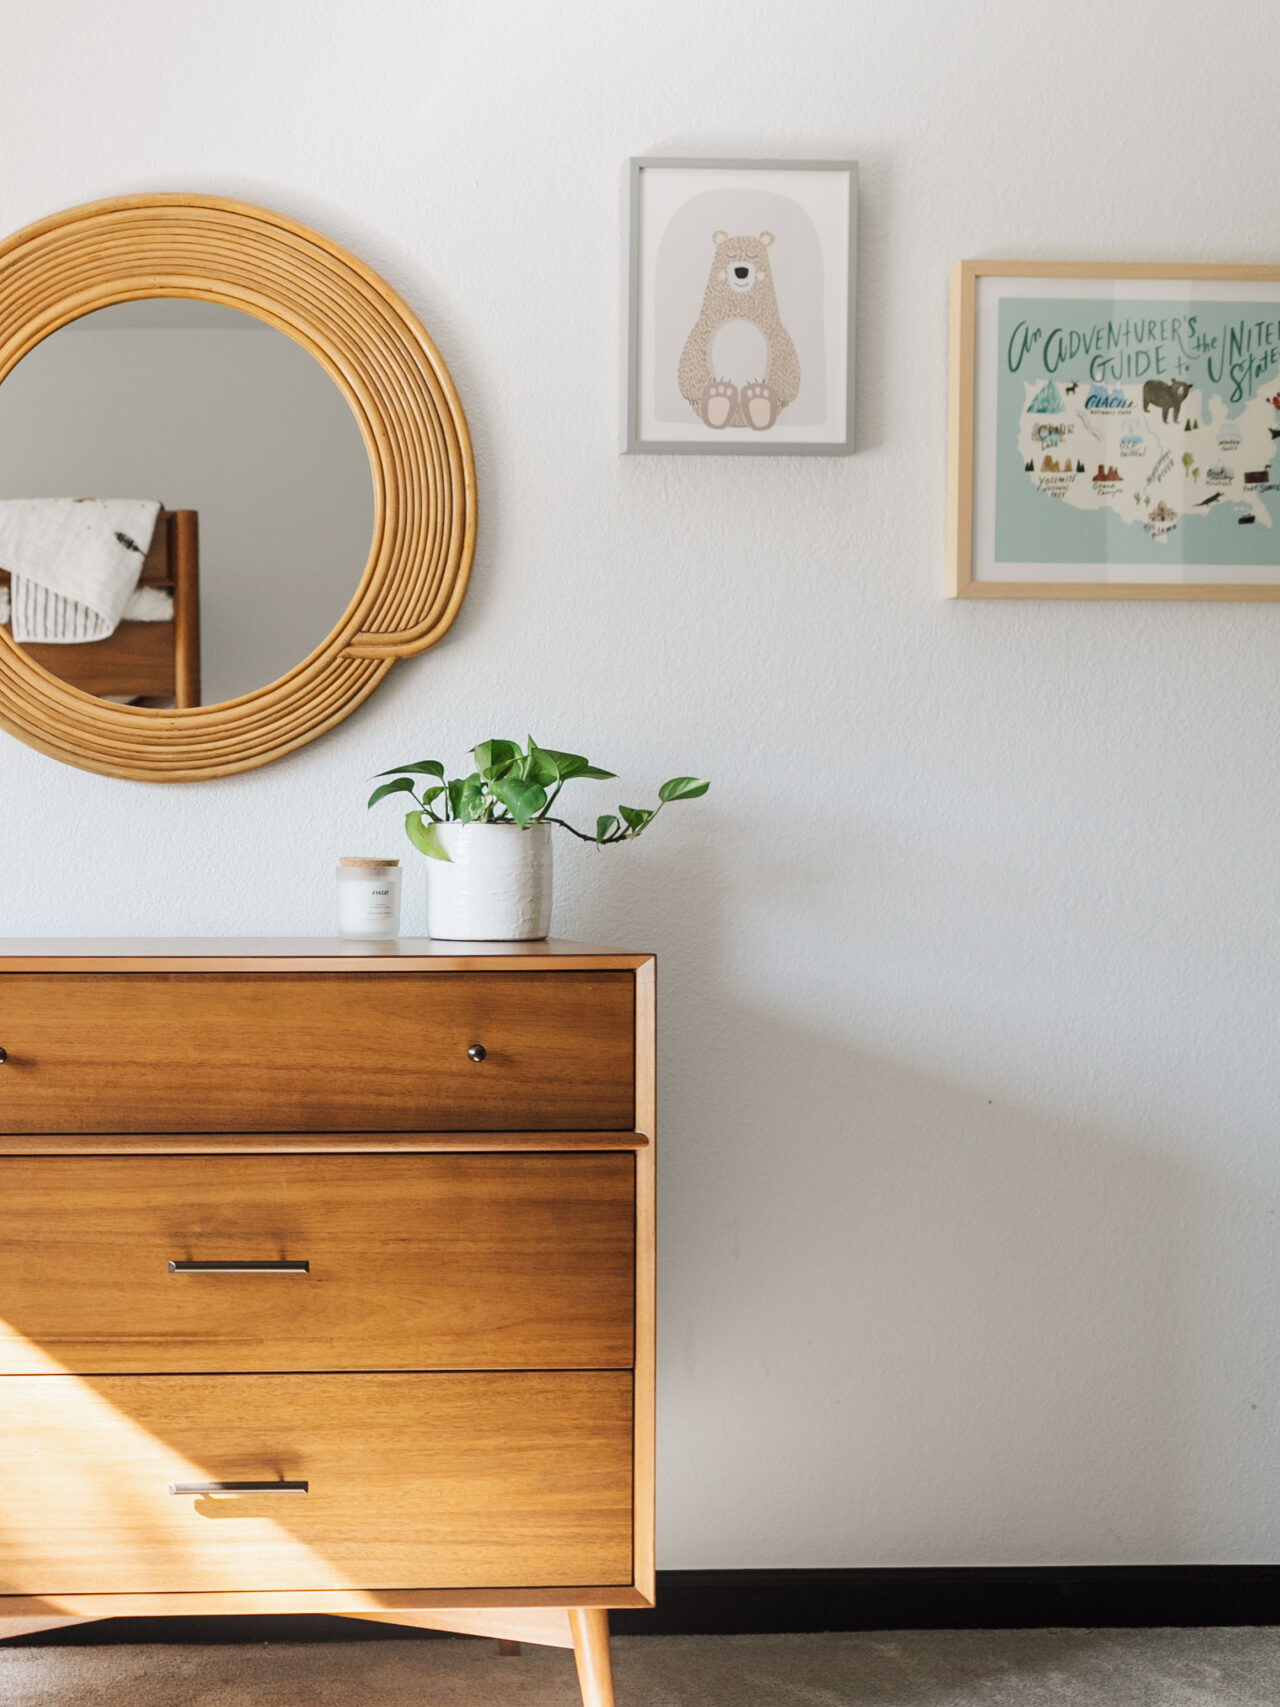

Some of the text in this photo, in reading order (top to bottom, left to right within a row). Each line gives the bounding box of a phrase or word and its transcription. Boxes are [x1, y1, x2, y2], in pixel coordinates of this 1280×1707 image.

[1008, 320, 1041, 372] An
[1089, 320, 1280, 383] GUIDE to the UNITE
